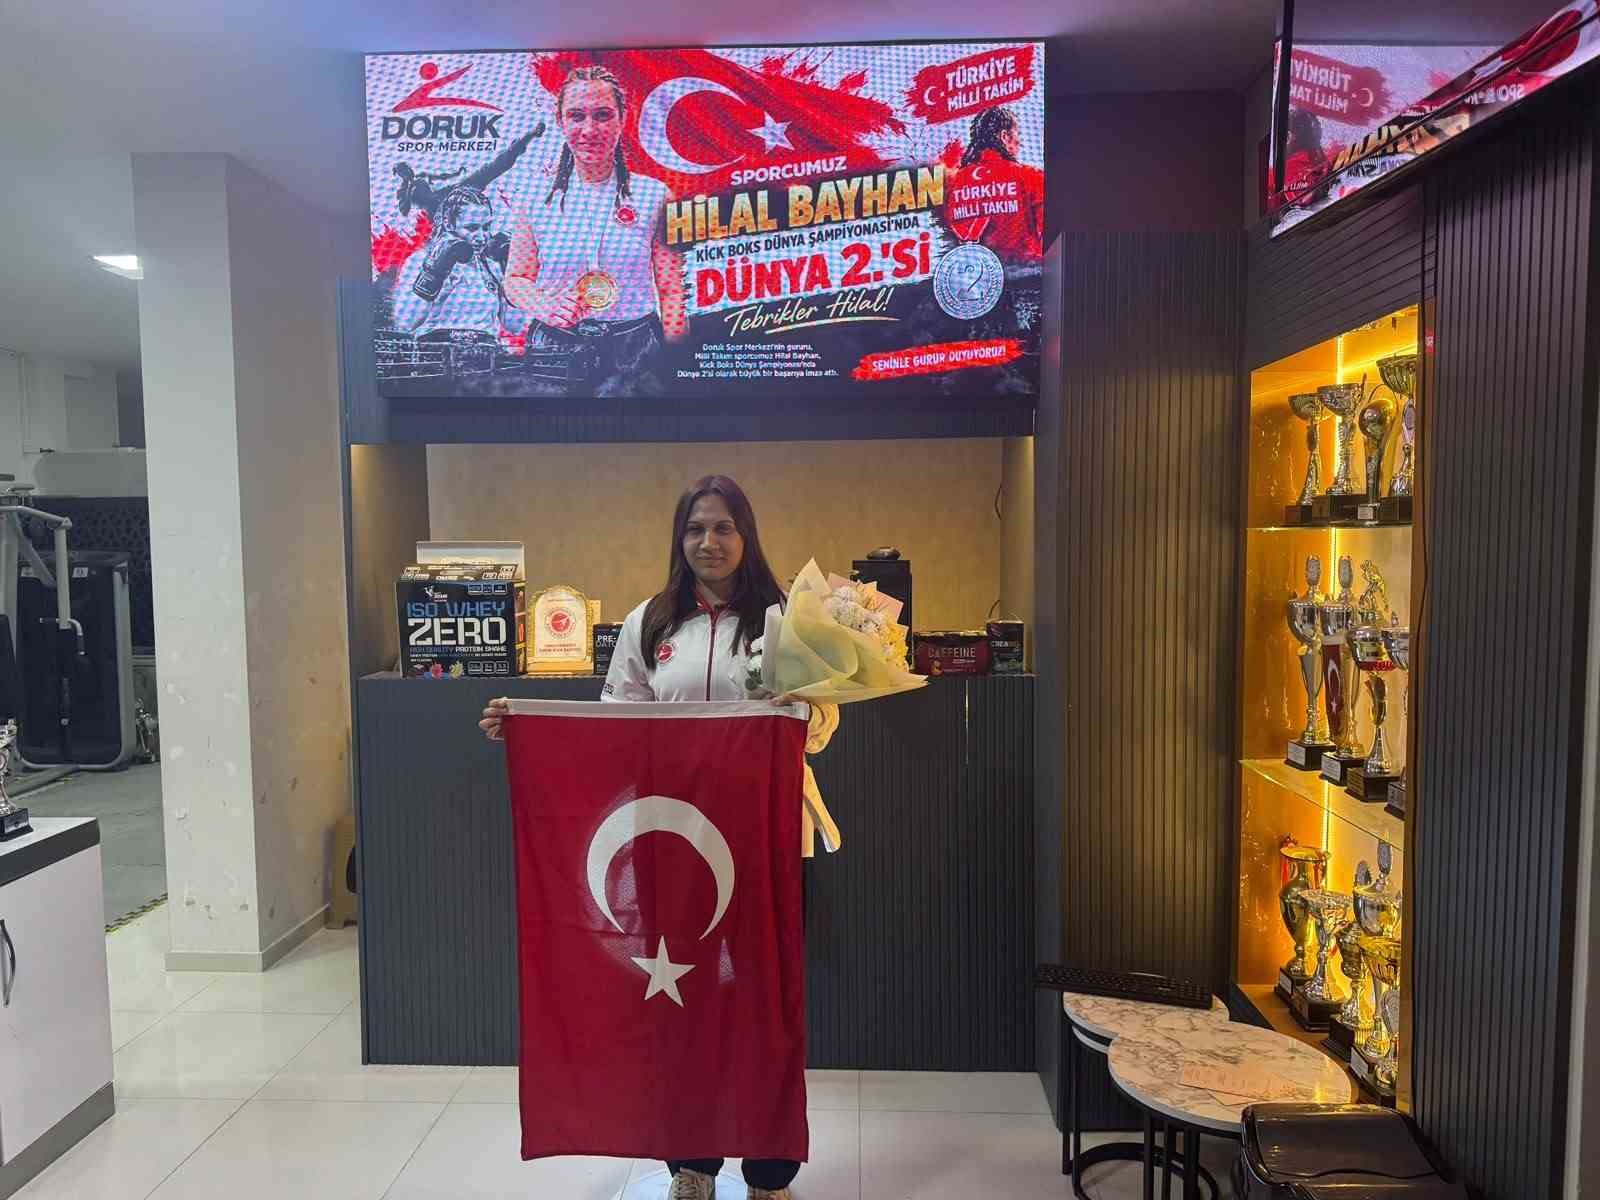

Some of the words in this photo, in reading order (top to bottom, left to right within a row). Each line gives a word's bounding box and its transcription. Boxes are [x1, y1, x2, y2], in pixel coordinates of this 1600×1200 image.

[945, 56, 1015, 91] TÜRKİYE
[947, 86, 980, 112] MİLLİ
[381, 114, 501, 140] DORUK
[398, 141, 433, 152] SPOR
[438, 139, 497, 151] MERKEZİ
[730, 156, 847, 186] SPORCUMUZ
[953, 181, 1017, 203] TÜRKİYE
[666, 189, 778, 245] HİLAL
[788, 166, 945, 228] BAYHAN
[953, 205, 980, 221] MİLLİ
[728, 242, 761, 258] BOKS
[764, 235, 805, 252] DÜNYA
[697, 254, 832, 308] DÜNYA
[841, 231, 931, 288] 2.'Sİ
[724, 298, 818, 337] Tebrikler
[829, 287, 895, 318] Hilal!
[726, 343, 743, 353] Spor
[774, 352, 791, 360] Hilal
[872, 356, 909, 372] SENİNLE
[913, 352, 945, 366] GURUR
[949, 346, 1006, 361] DUYUYORUZ!
[677, 370, 700, 378] Dünya
[715, 369, 738, 377] olarak
[739, 369, 762, 378] büyük
[763, 369, 773, 377] bir
[805, 369, 823, 377] imza
[407, 601, 438, 617] ISO
[446, 601, 506, 617] WHEY
[408, 617, 507, 645] ZERO
[928, 647, 976, 658] CAFFEINE
